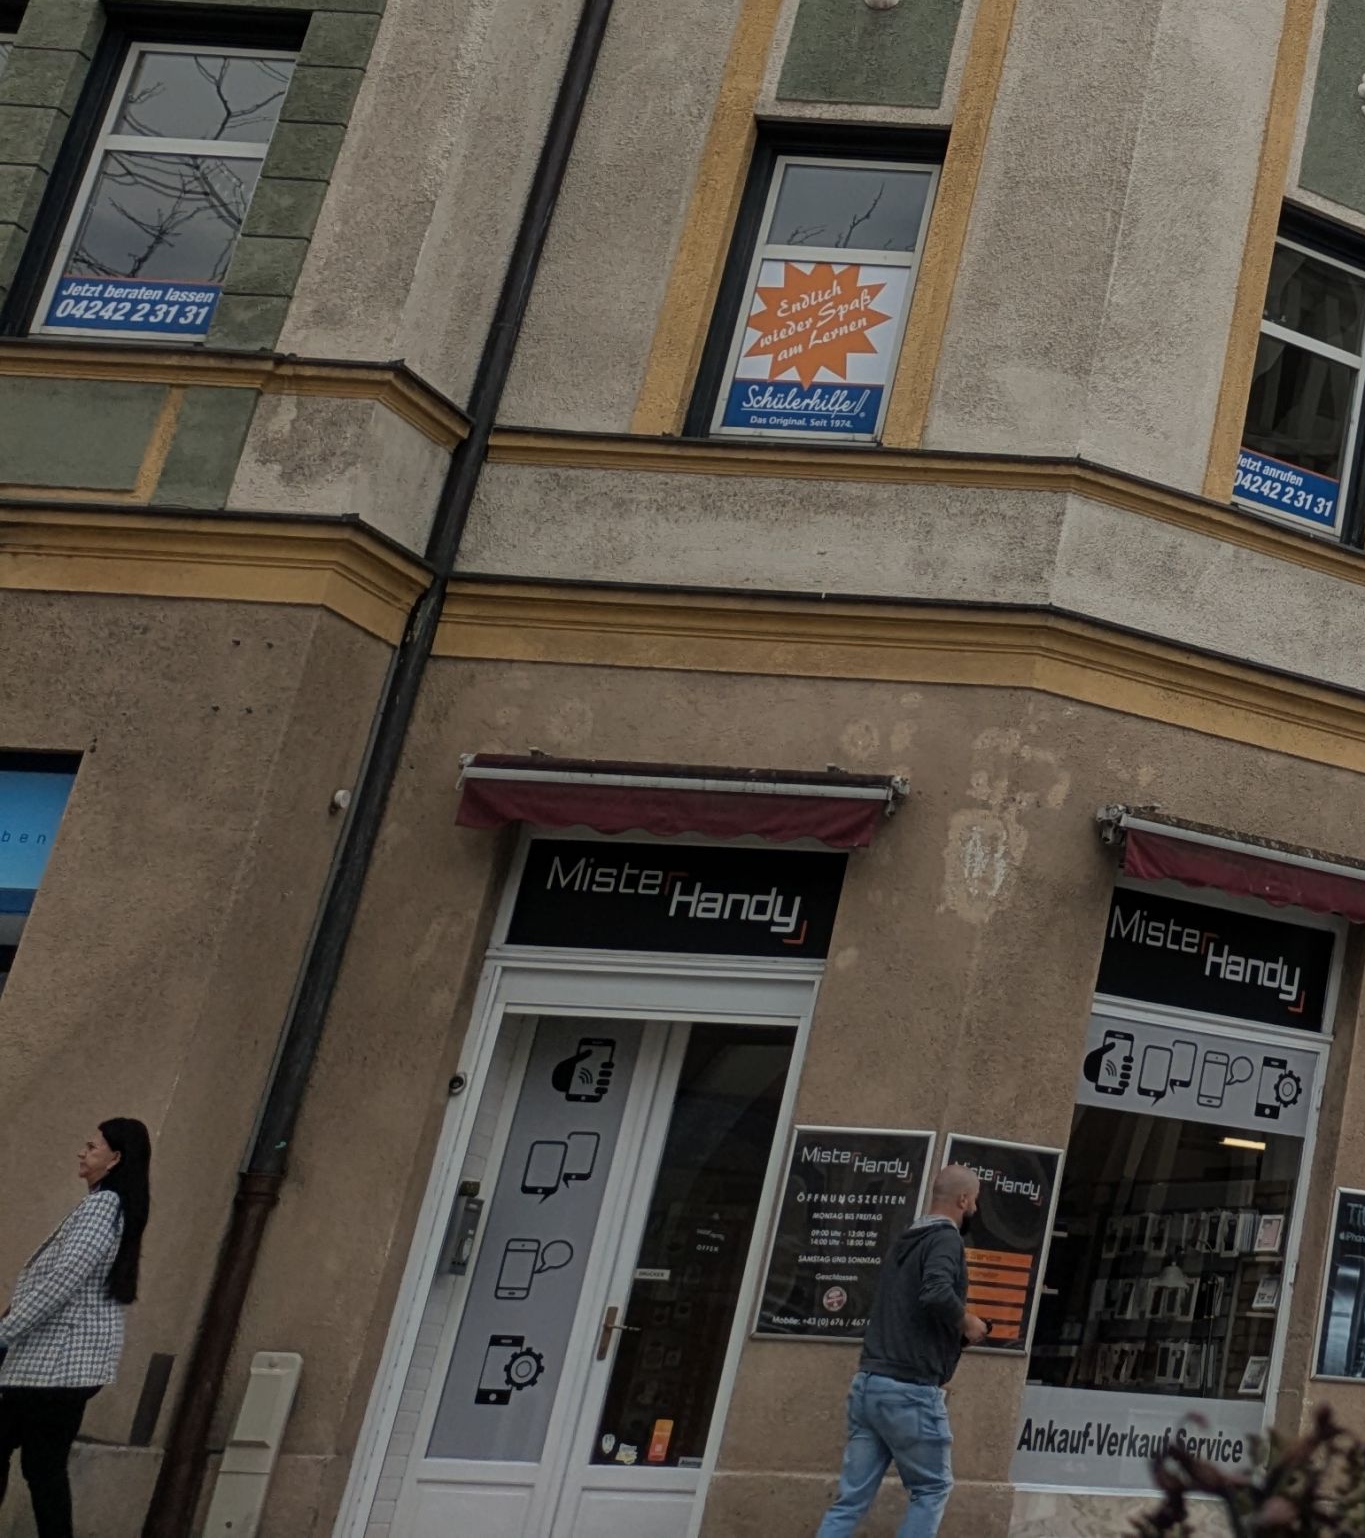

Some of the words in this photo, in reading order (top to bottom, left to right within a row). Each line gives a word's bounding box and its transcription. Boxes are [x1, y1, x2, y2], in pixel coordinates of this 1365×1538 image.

[62, 282, 103, 297] Jetzt
[103, 284, 161, 300] beraten
[164, 288, 215, 303] lassen
[777, 280, 842, 317] Endlich
[55, 299, 130, 321] 04242
[130, 303, 150, 321] 2
[149, 304, 179, 324] 31
[179, 306, 210, 325] 31
[760, 317, 813, 348] wieder
[816, 289, 872, 327] Spaß
[777, 344, 803, 361] am
[808, 317, 868, 349] Lernen
[750, 415, 767, 424] Das
[768, 416, 808, 427] Original.
[809, 418, 828, 427] Seit
[830, 419, 854, 428] 1974.
[1262, 465, 1304, 486] anrufen
[1281, 486, 1295, 504] 2
[1293, 491, 1314, 511] 31
[1313, 497, 1334, 517] 31
[546, 855, 690, 896] Mister
[668, 881, 802, 933] Handy
[1110, 905, 1220, 955] Mister
[1204, 942, 1300, 1001] Handy
[854, 1157, 910, 1179] Handy
[796, 1191, 907, 1205] ÖFFNUNGSZEITEN
[994, 1174, 1041, 1201] Handy
[812, 1212, 843, 1220] MONTAG
[855, 1213, 883, 1222] FREITAG
[797, 1255, 831, 1263] SAMSTAG
[847, 1256, 881, 1265] SONNTAG
[815, 1273, 858, 1281] Geschlossen
